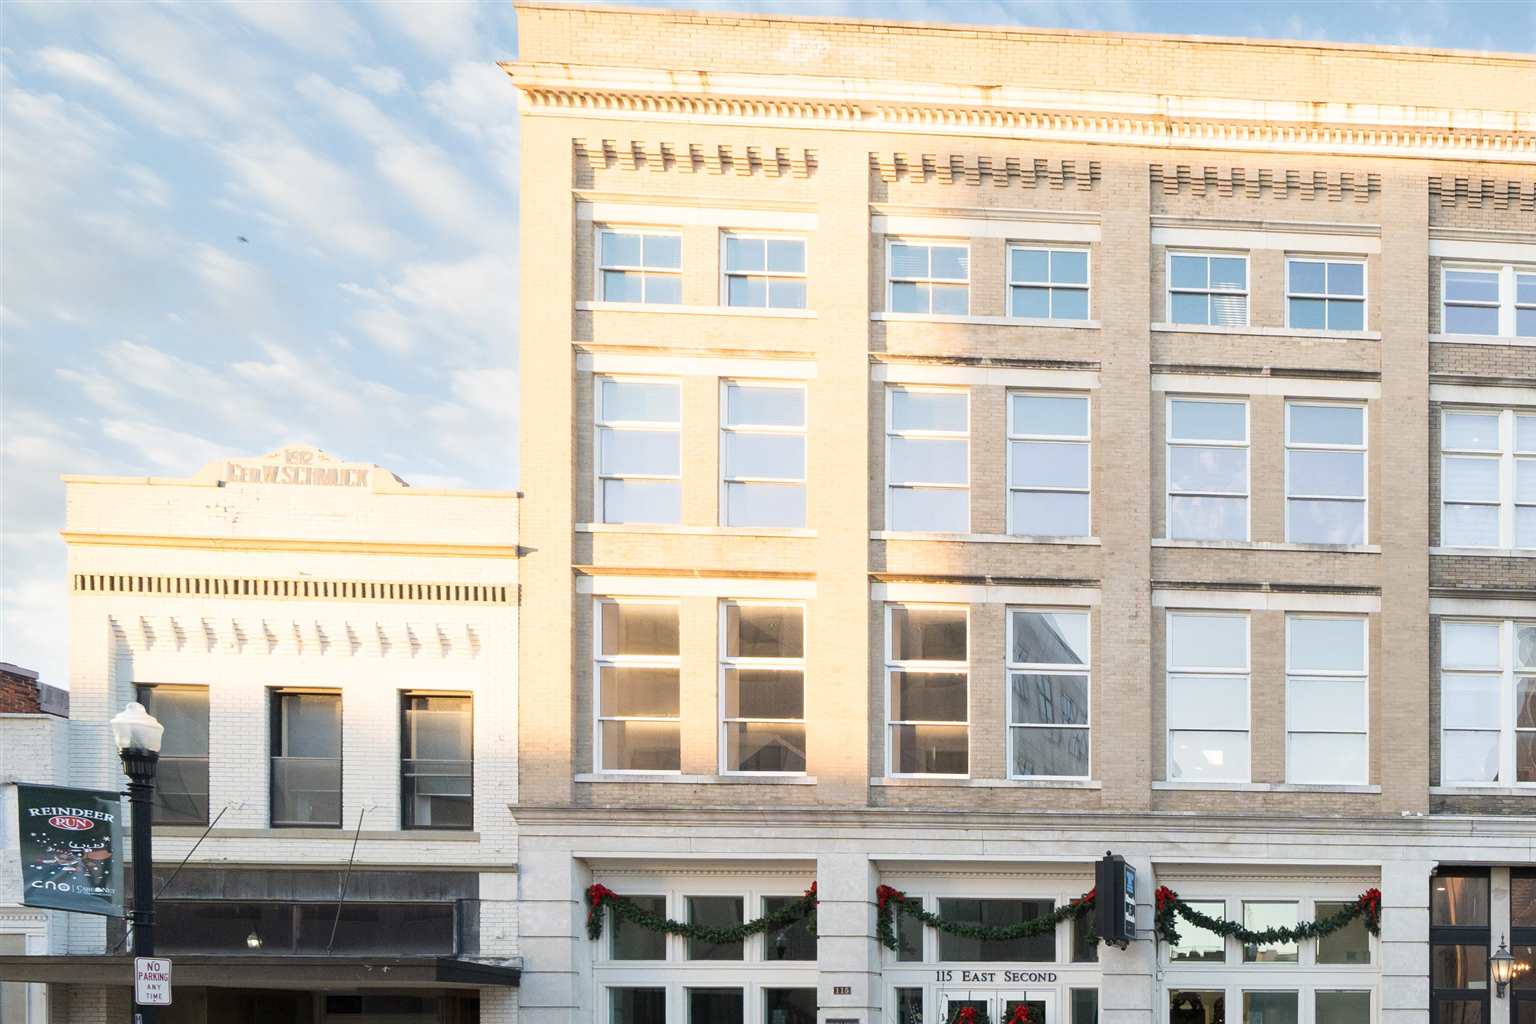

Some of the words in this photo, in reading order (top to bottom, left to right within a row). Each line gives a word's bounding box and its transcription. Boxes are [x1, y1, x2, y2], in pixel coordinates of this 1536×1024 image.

[28, 806, 115, 823] REINDEER
[56, 817, 87, 829] RUN
[147, 962, 161, 972] NO
[138, 972, 169, 982] PARKING
[936, 970, 953, 982] 115
[962, 970, 996, 982] EAST
[1004, 970, 1057, 982] SECOND
[147, 983, 161, 991] ANY
[146, 992, 162, 1000] TIME
